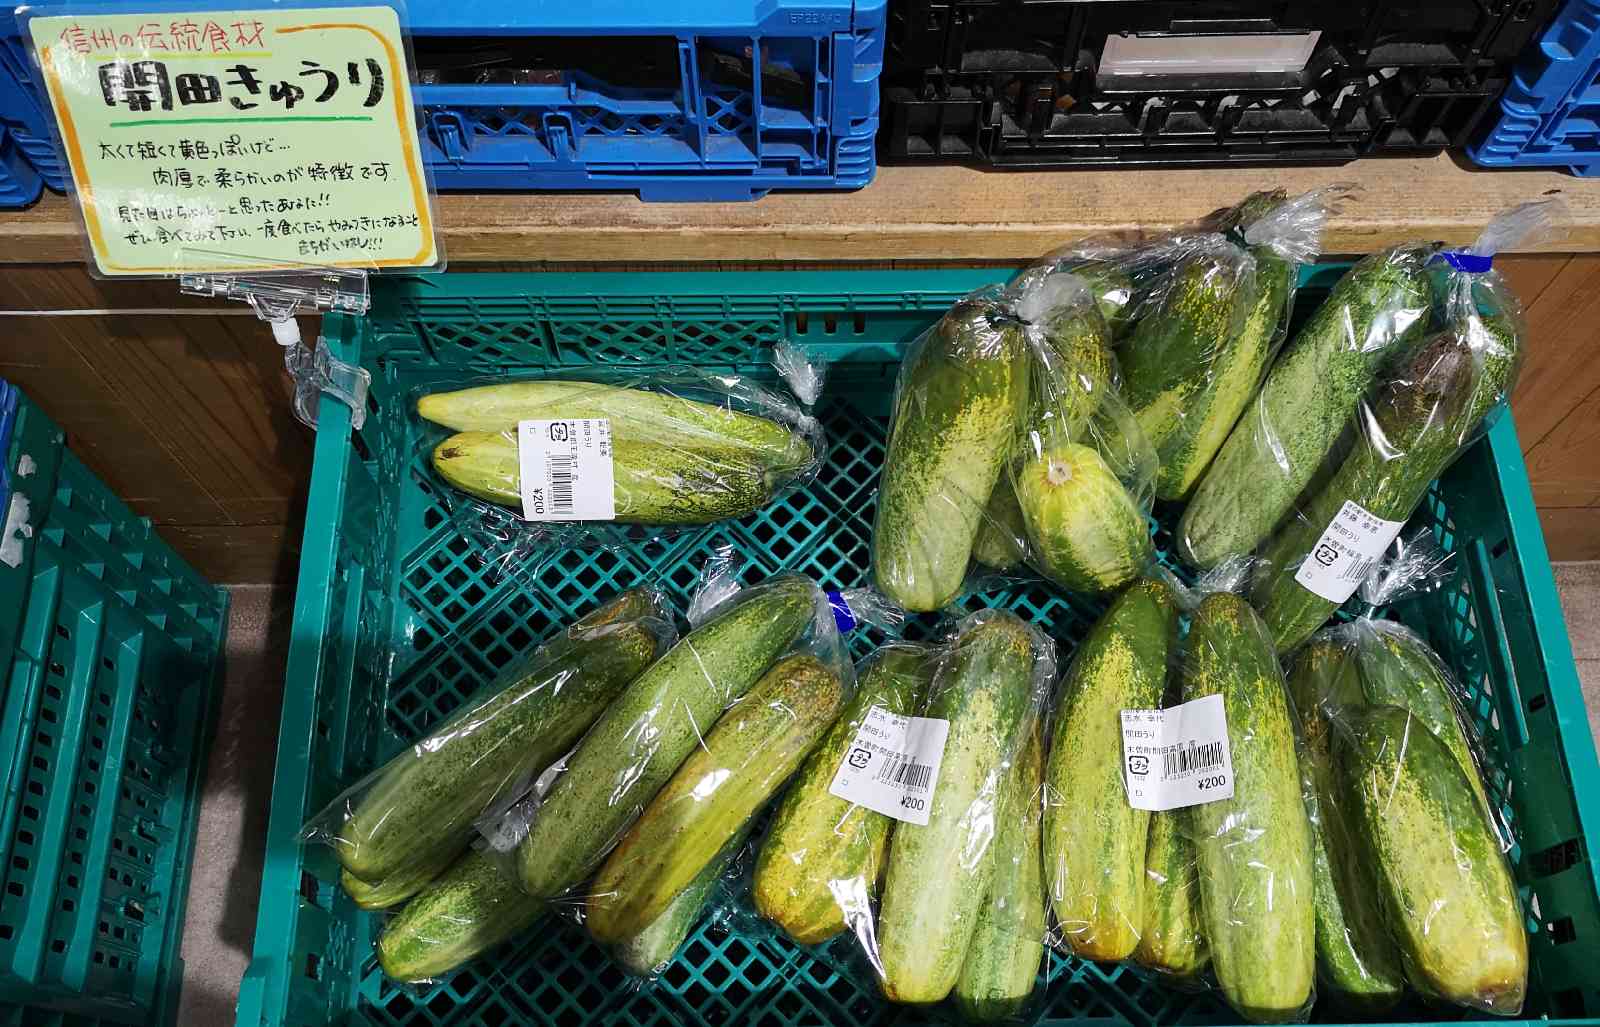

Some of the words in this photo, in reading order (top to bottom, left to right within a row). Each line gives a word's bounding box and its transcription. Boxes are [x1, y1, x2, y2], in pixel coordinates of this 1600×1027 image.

[59, 21, 265, 54] 信州の伝統食材
[98, 58, 385, 111] 開田きゅうり
[533, 487, 545, 514] ¥200
[1198, 775, 1226, 791] ¥200
[901, 795, 925, 811] ¥200
